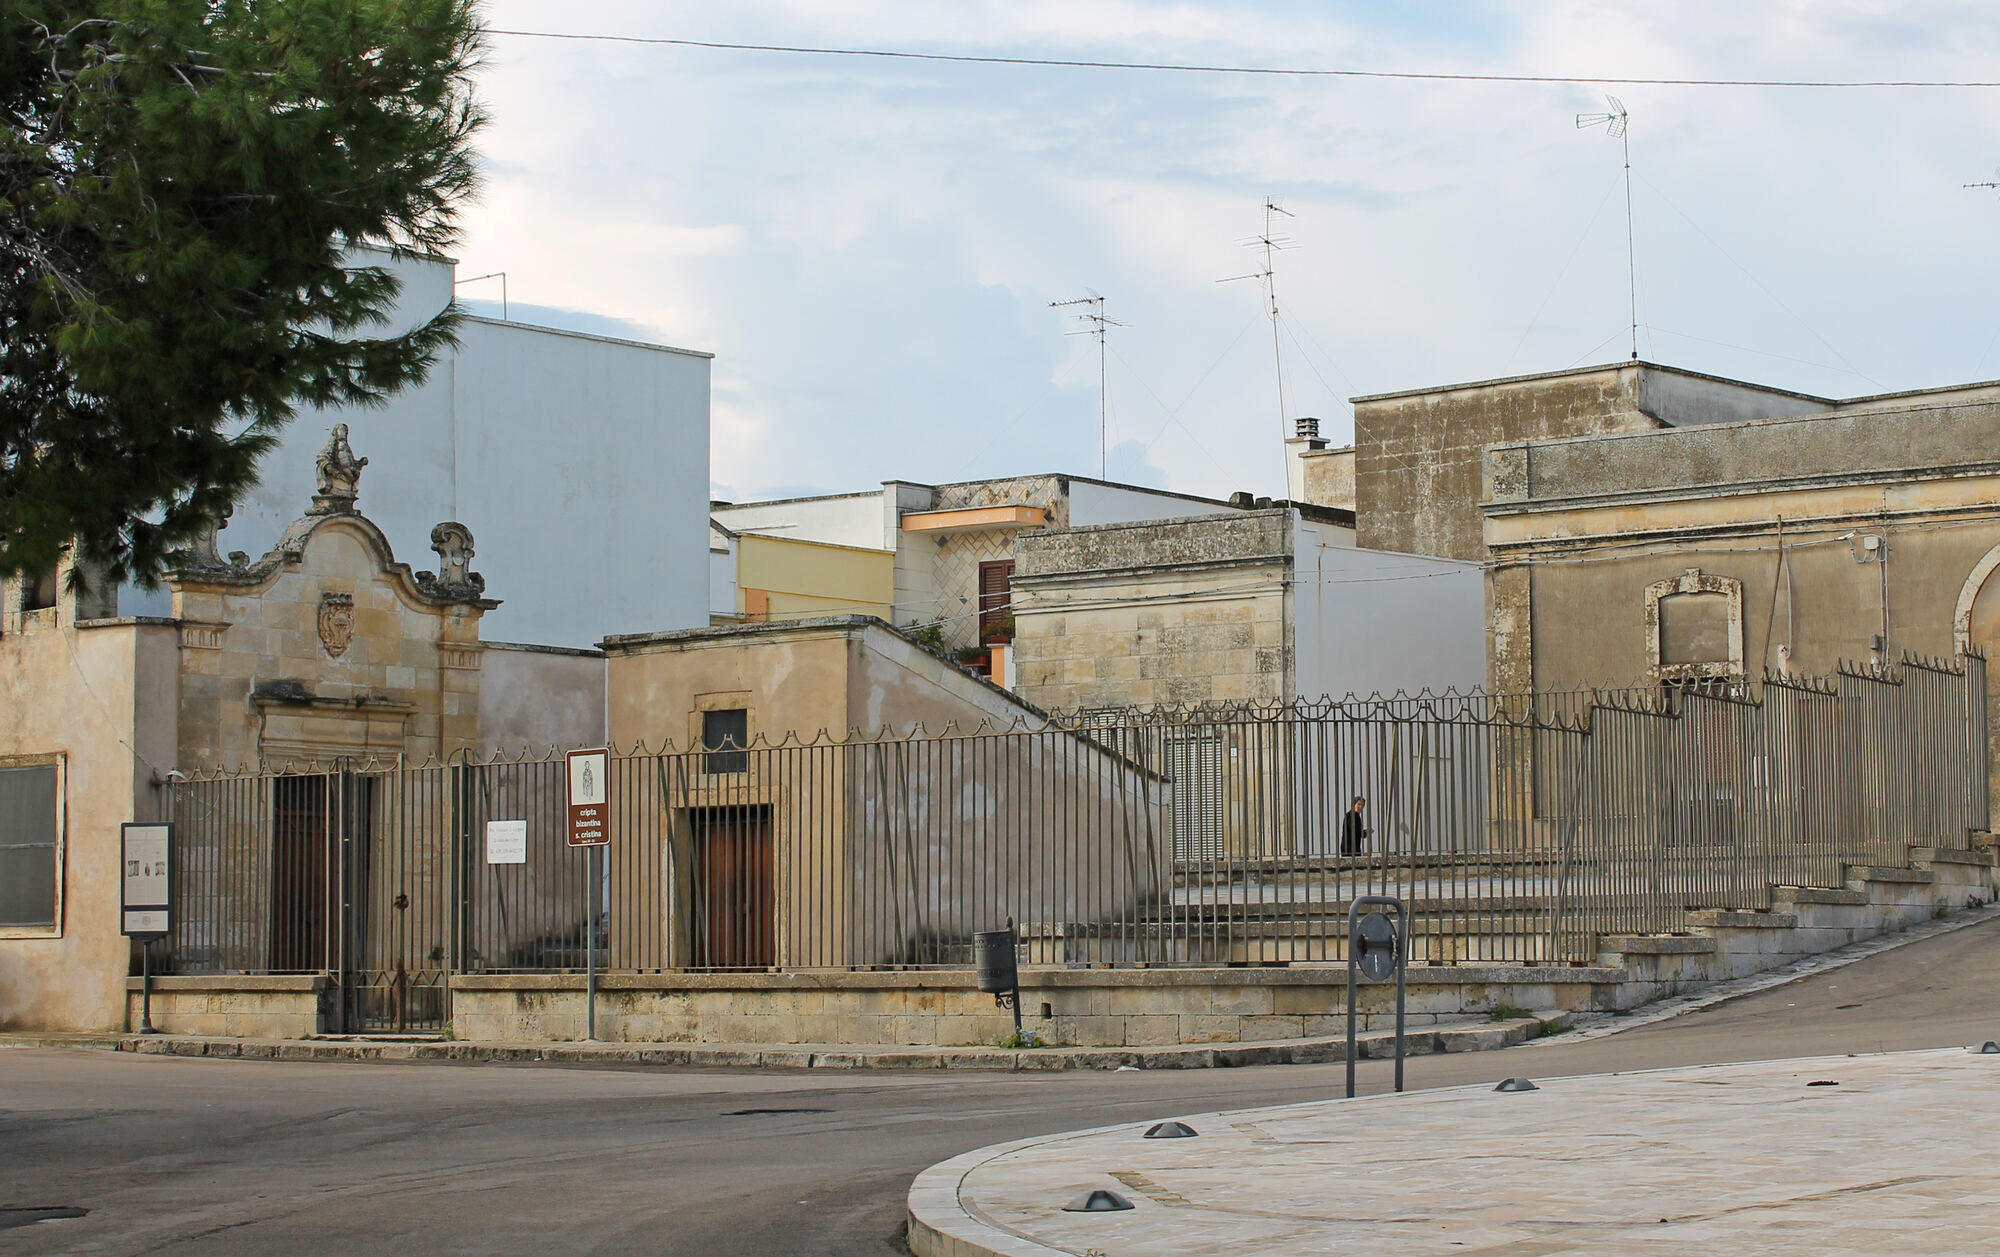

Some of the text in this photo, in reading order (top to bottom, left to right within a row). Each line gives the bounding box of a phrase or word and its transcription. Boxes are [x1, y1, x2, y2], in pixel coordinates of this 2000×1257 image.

[580, 808, 597, 818] cripta
[576, 819, 601, 828] bizantina
[581, 830, 602, 838] cristina
